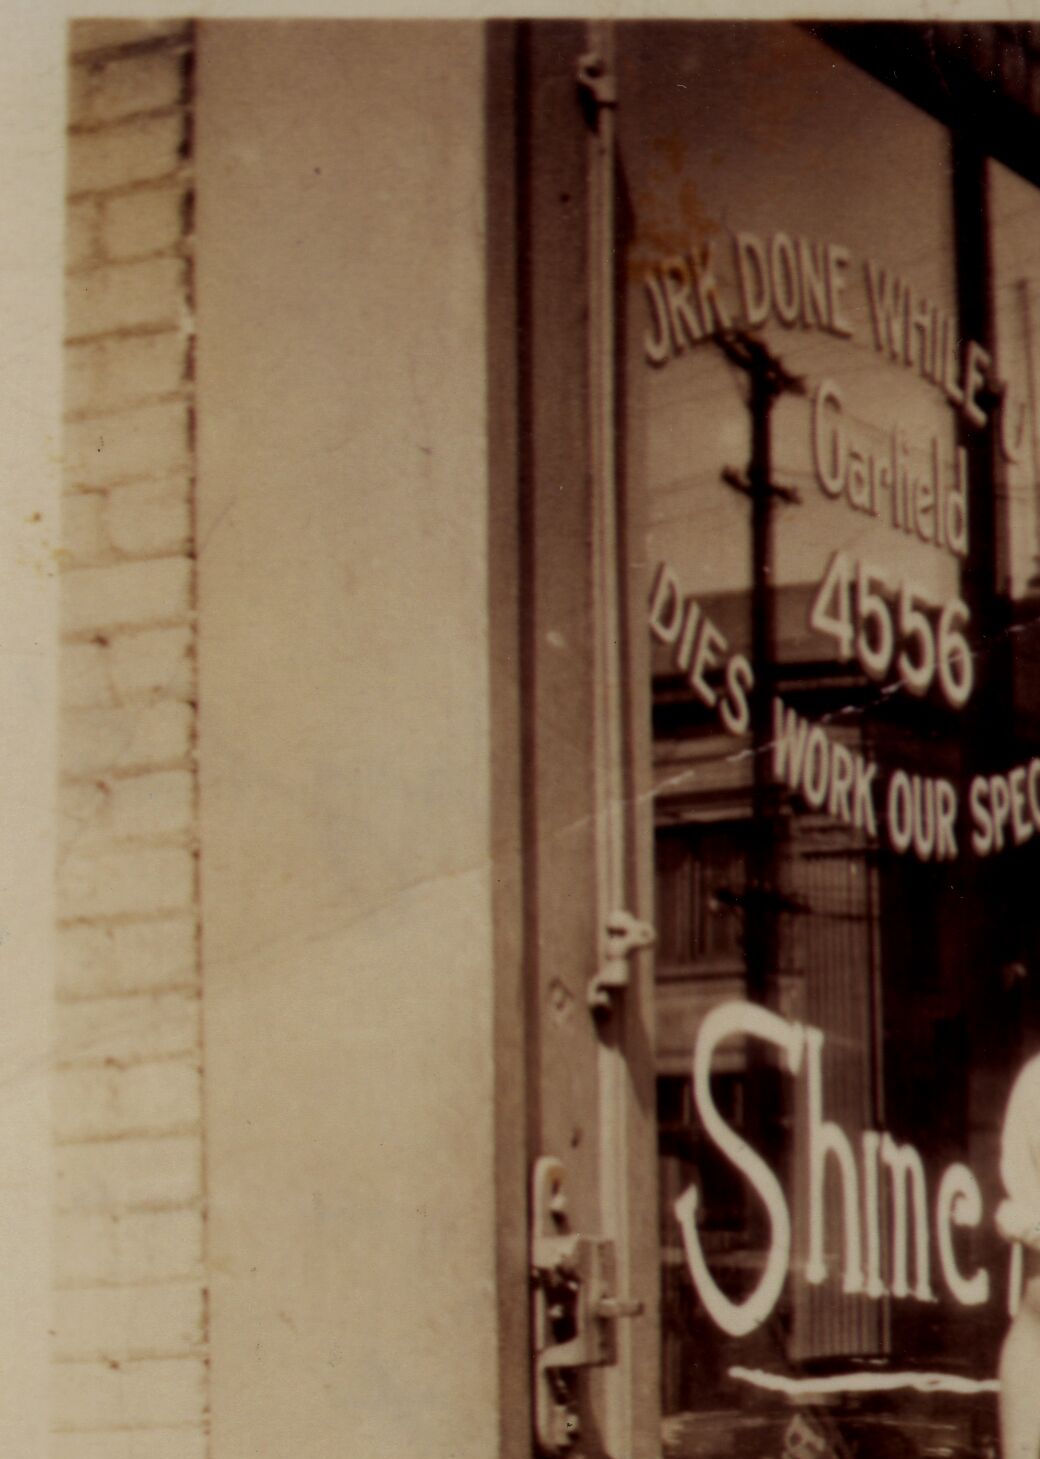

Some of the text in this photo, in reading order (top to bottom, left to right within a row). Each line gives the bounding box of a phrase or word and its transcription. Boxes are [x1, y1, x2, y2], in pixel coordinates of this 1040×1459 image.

[737, 232, 851, 335] DONE
[864, 258, 993, 427] WHILE
[811, 378, 969, 557] Garfield
[811, 550, 974, 706] 4556
[773, 696, 877, 838] WORK
[887, 769, 958, 861] OUR
[674, 1000, 990, 1337] Shine
